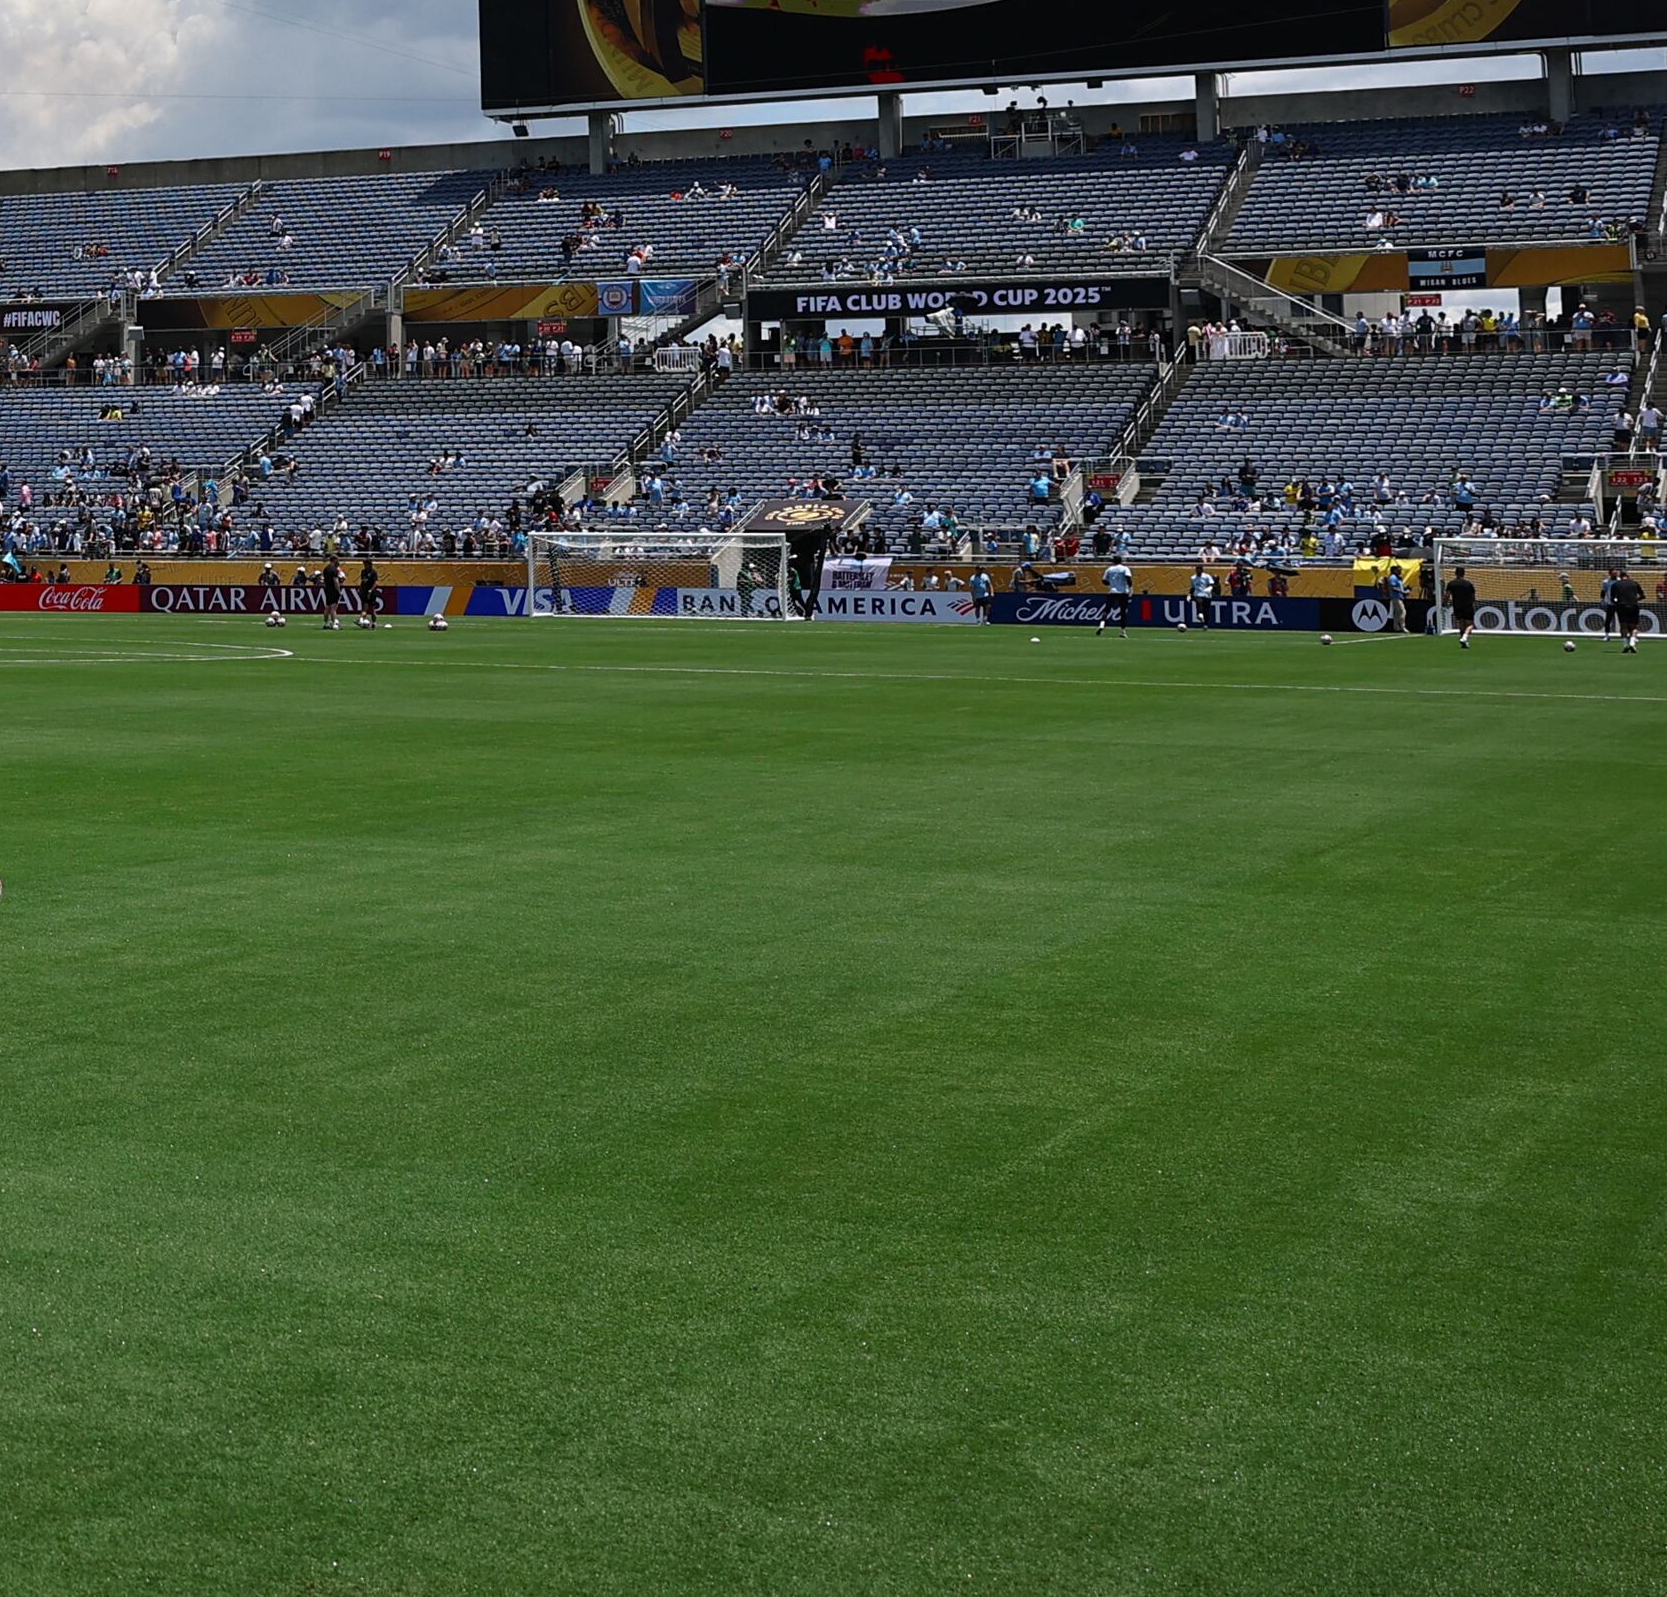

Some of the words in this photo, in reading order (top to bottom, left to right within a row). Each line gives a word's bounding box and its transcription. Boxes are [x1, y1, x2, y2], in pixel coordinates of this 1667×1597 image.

[1427, 249, 1464, 259] MCFC
[796, 295, 839, 313] FIFA
[846, 293, 902, 311] CLUB
[906, 290, 988, 309] WOD
[992, 288, 1039, 307] CUP
[3, 310, 61, 328] #FIFACWC
[38, 585, 108, 611] Coca-Cola
[150, 586, 247, 613] QATAR
[259, 586, 385, 612] AIRWAYS
[494, 588, 574, 615] VISA
[682, 594, 736, 613] BAN
[812, 596, 937, 616] AMERICA
[1163, 599, 1279, 625] ULTRA
